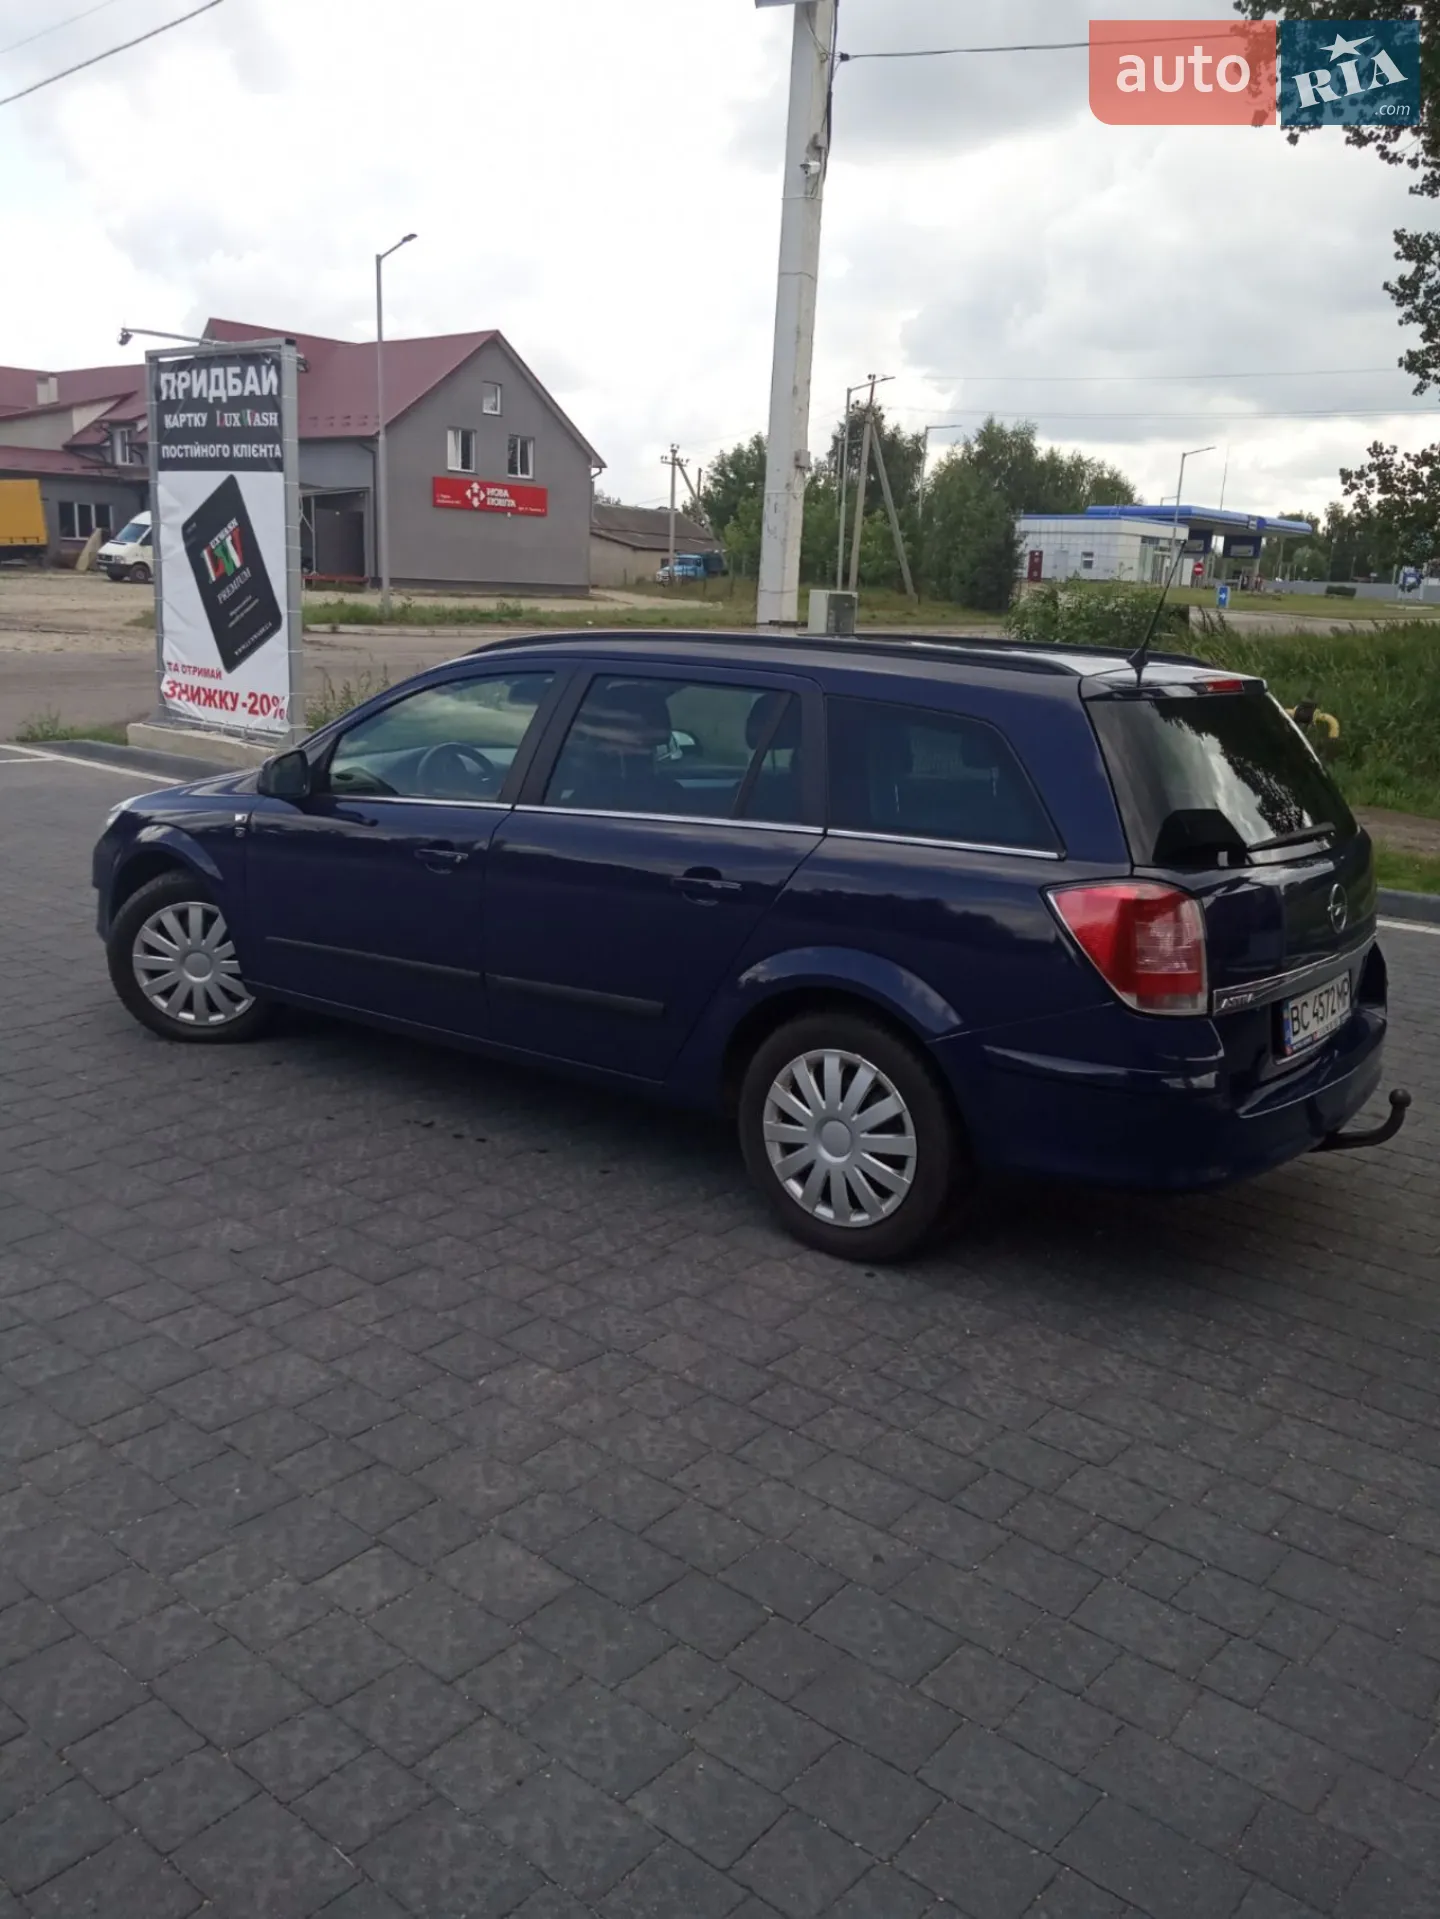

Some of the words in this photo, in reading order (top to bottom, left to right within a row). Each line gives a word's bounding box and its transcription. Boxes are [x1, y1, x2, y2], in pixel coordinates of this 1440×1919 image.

[160, 358, 278, 403] ПРИДБАЙ
[164, 412, 208, 429] КАРТКУ
[161, 441, 230, 458] ПОСТІЙНОГО
[233, 443, 282, 458] КЛІЄНТА
[166, 662, 180, 673] ТА
[181, 664, 223, 681] ОТРИМАЙ
[164, 679, 240, 712] ЗНИЖКУ
[1290, 1001, 1310, 1037] BC
[1312, 985, 1336, 1024] 4572
